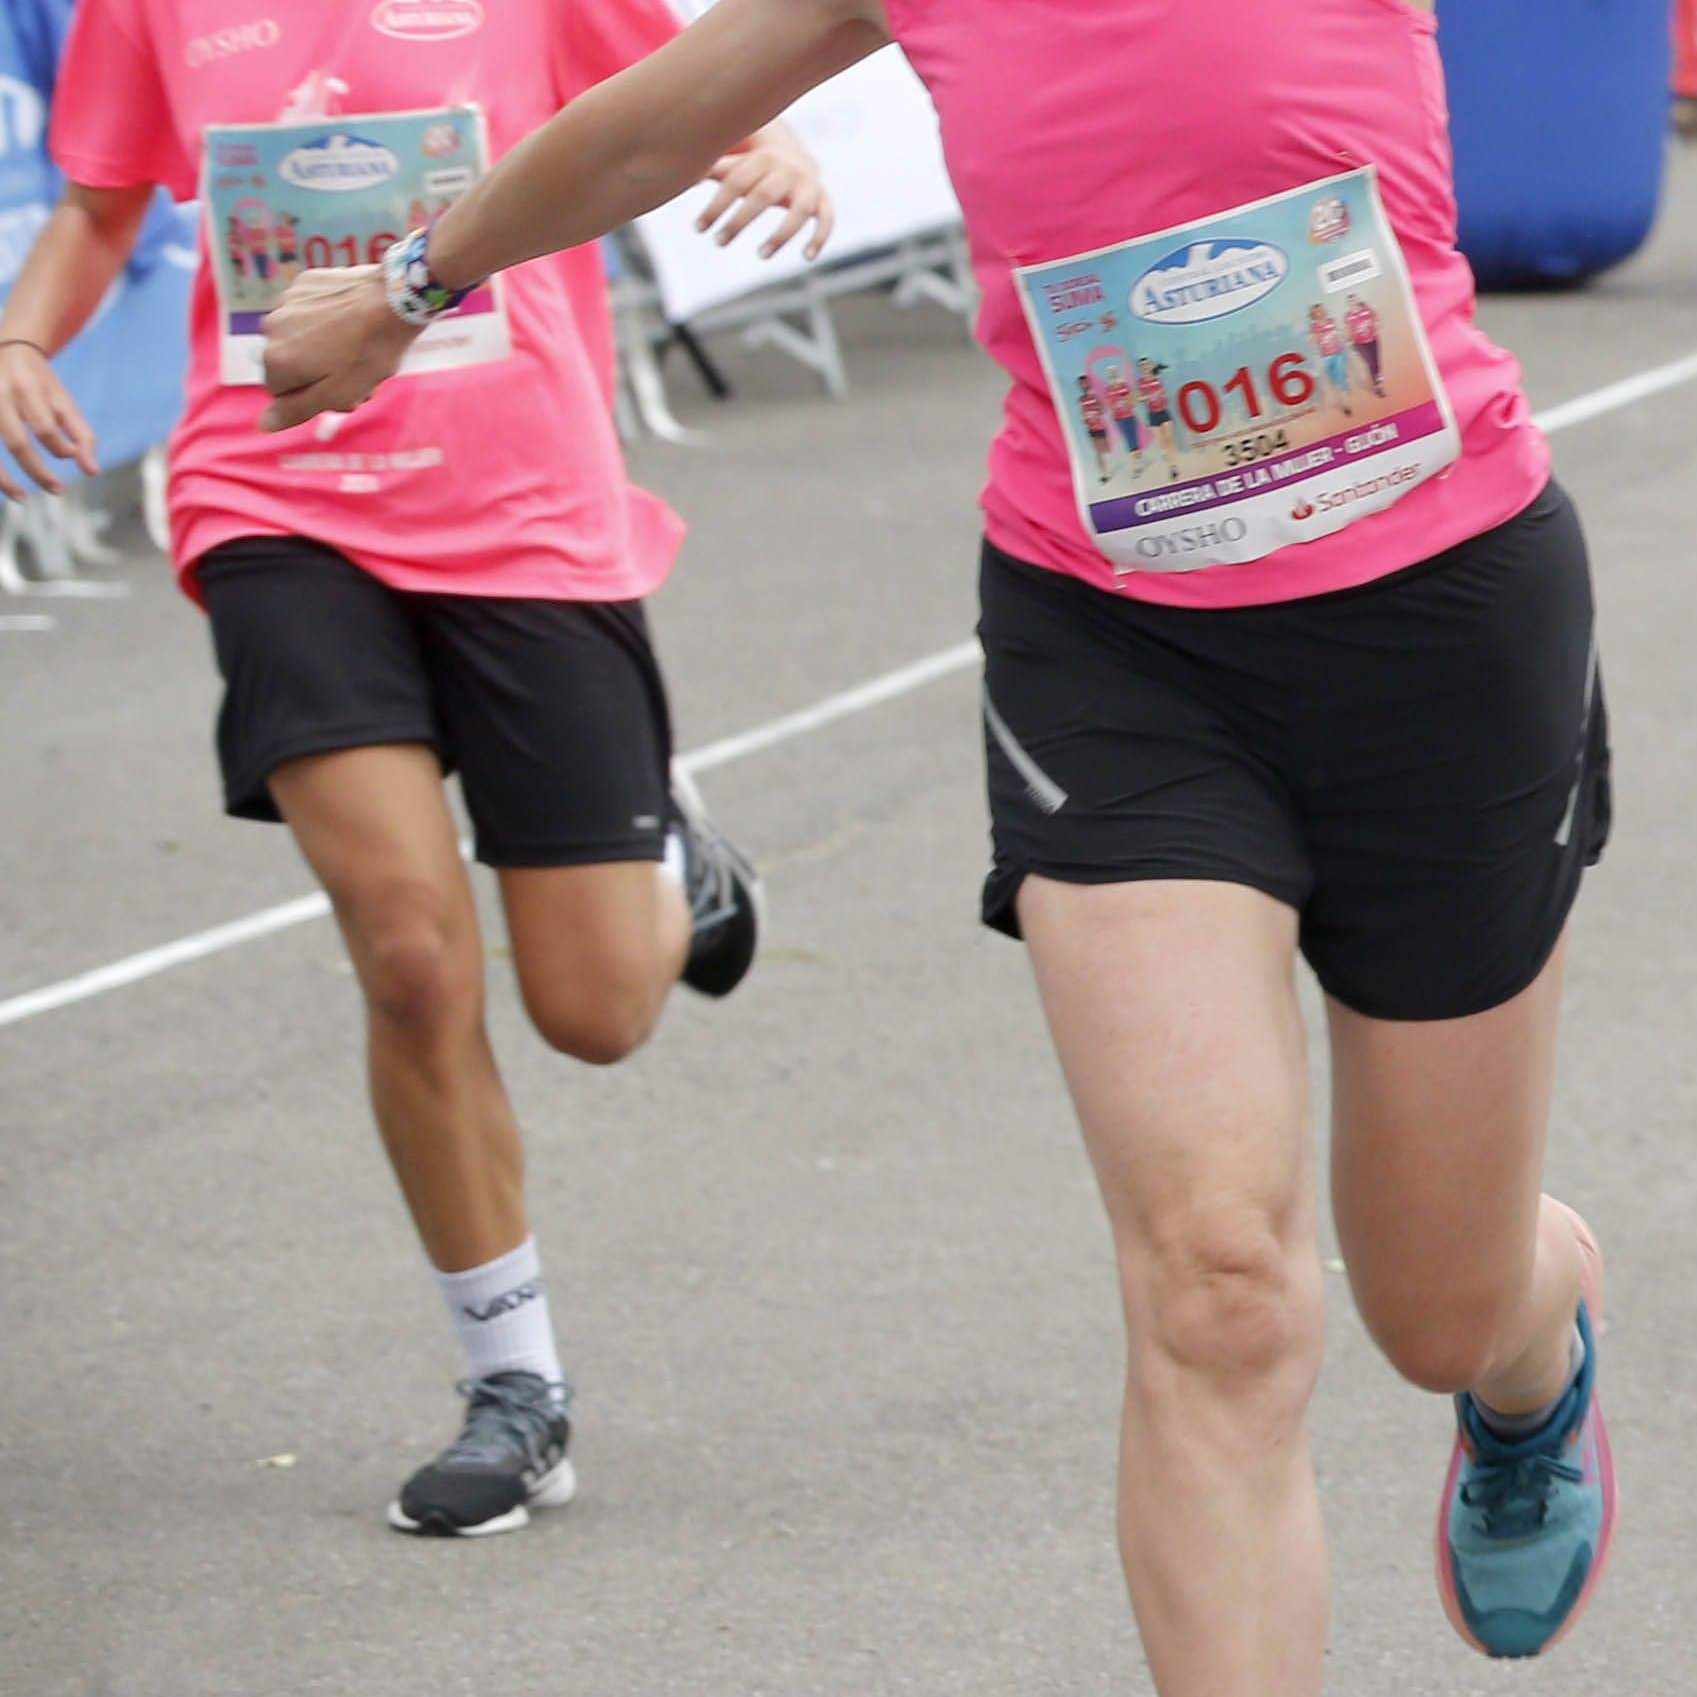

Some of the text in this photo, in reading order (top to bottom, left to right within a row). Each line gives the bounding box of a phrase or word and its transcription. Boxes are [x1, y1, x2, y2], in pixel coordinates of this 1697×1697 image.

[1141, 259, 1281, 317] ASTURIANA
[1177, 352, 1316, 433] 016
[1222, 429, 1288, 466] 3504
[1136, 488, 1212, 517] CARRERA
[1216, 475, 1245, 497] DE
[1249, 468, 1271, 492] LA
[1317, 462, 1423, 513] Santander
[1135, 516, 1247, 558] OYSHO
